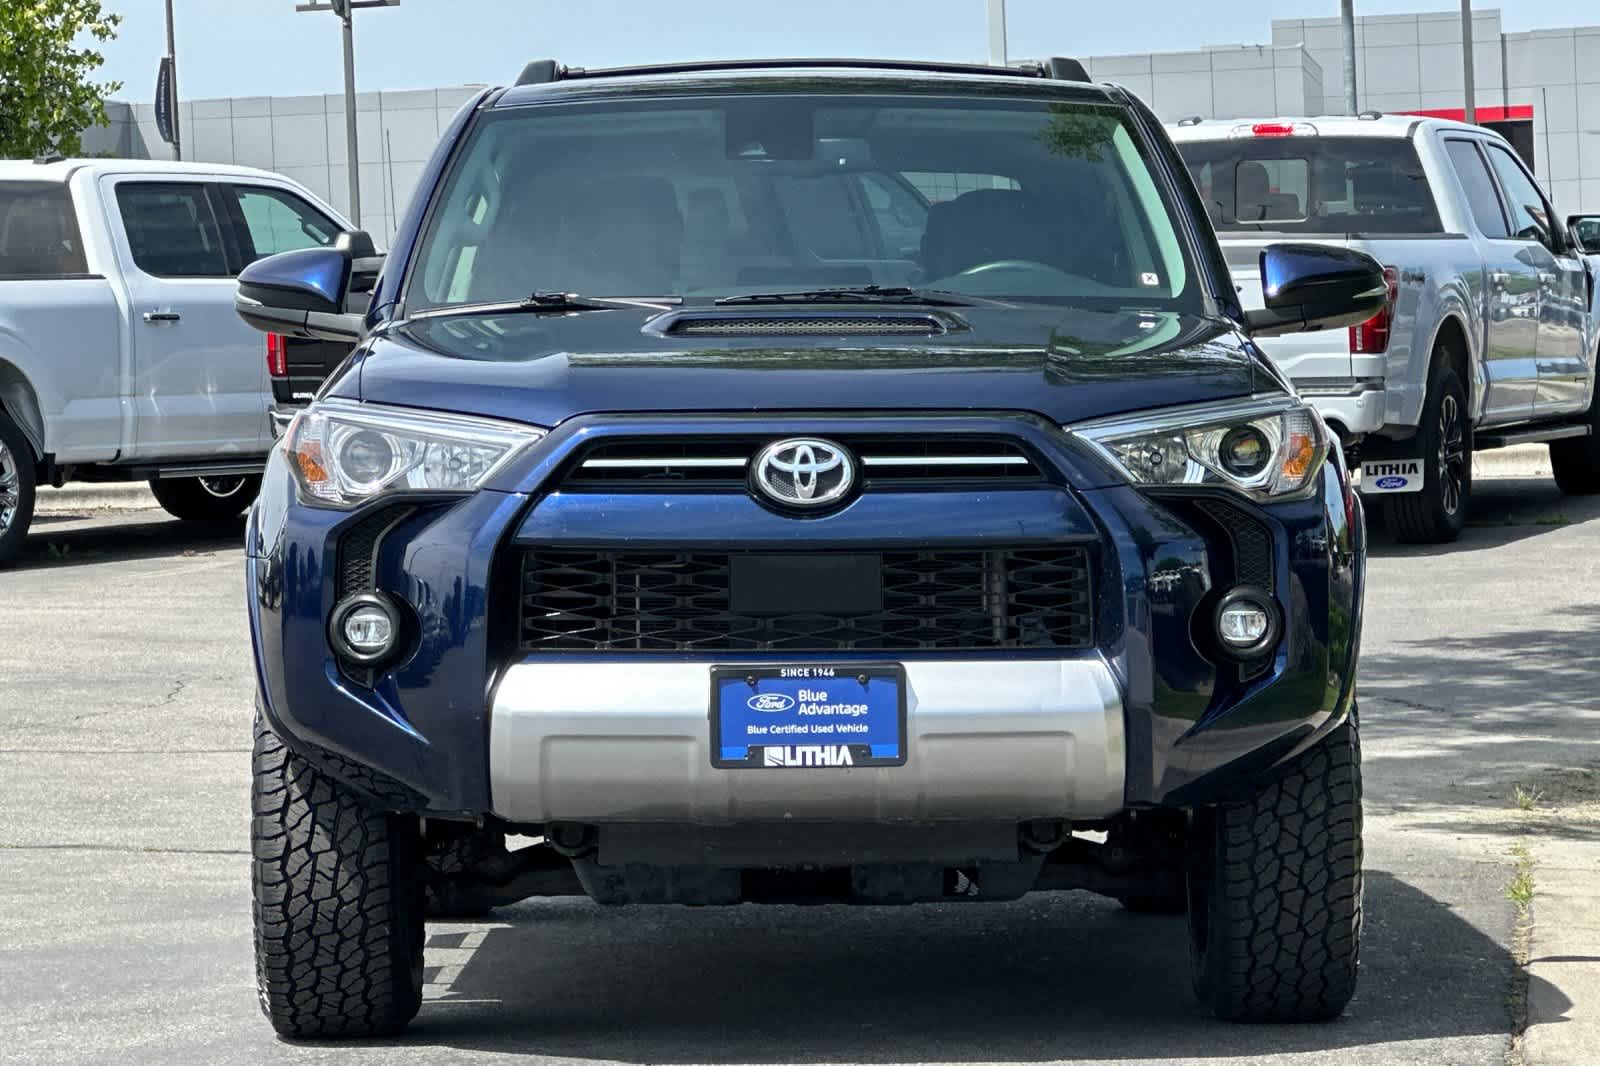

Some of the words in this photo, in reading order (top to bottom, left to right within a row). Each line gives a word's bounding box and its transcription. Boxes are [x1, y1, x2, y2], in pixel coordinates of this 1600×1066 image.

[1366, 463, 1418, 476] LITHIA
[1380, 478, 1403, 488] Ford
[781, 668, 810, 677] SINCE
[813, 667, 835, 677] 1946
[756, 695, 786, 709] Ford
[798, 689, 828, 702] Blue
[798, 703, 868, 716] Advantage
[747, 725, 768, 734] Blue
[770, 724, 808, 734] Certified
[811, 724, 834, 733] Used
[836, 723, 869, 733] Vehicle
[784, 745, 853, 766] LITHIA
